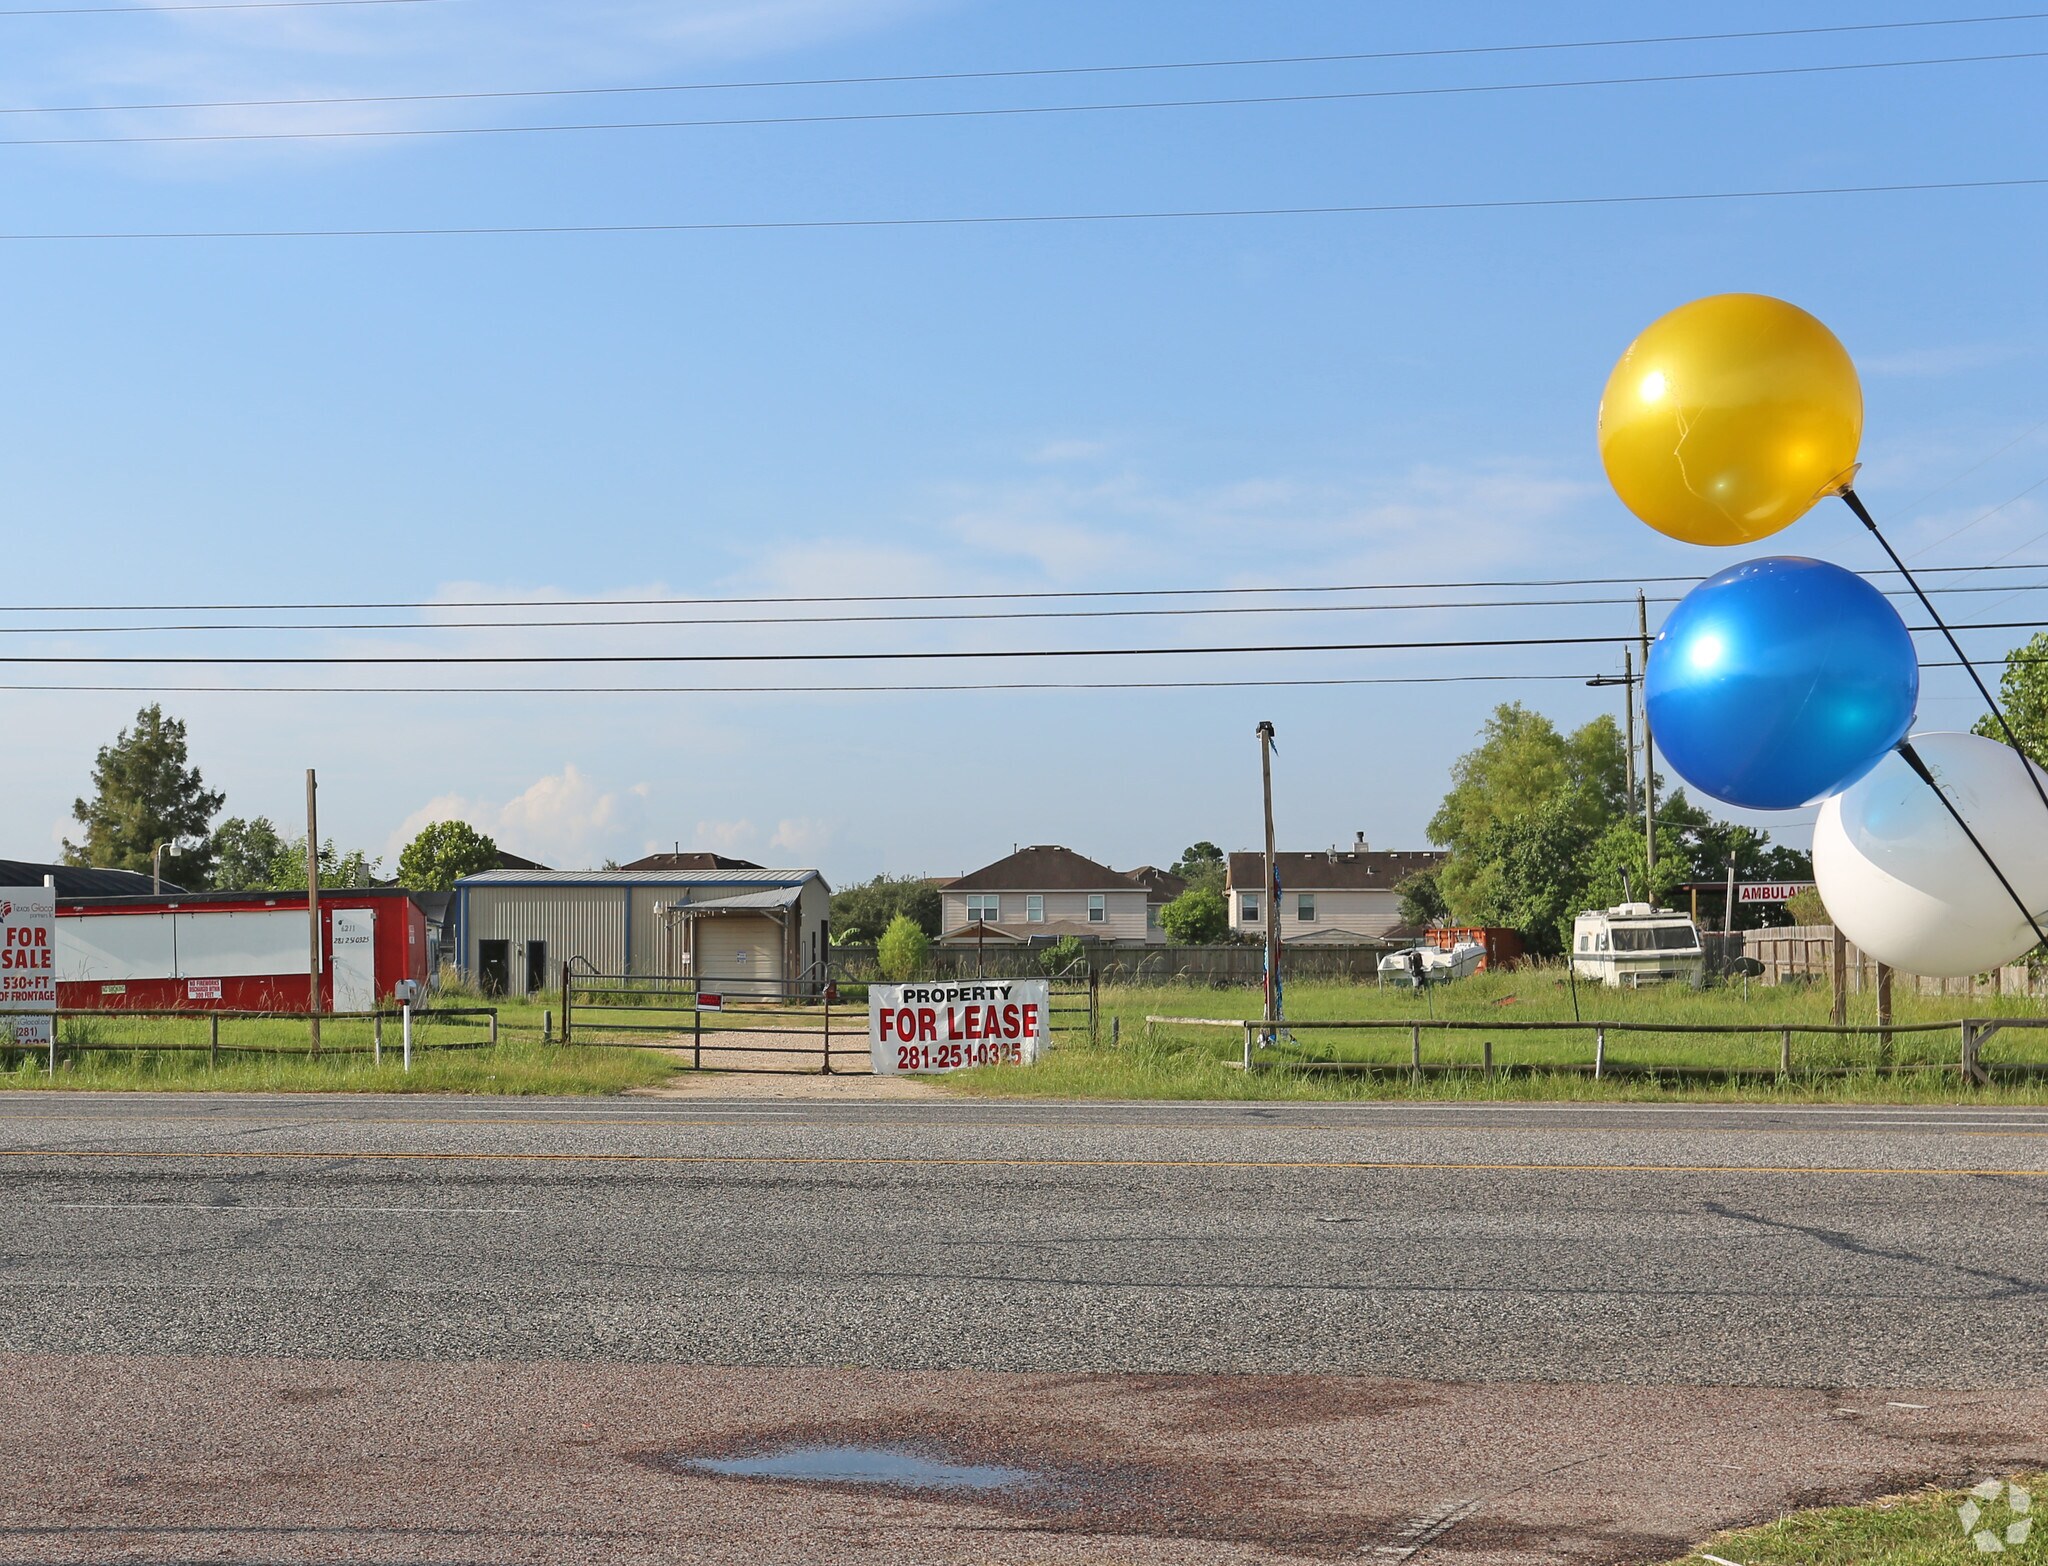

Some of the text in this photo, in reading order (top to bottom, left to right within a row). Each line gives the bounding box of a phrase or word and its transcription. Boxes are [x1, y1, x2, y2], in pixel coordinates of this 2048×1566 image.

[1742, 886, 1814, 899] AMBULA
[13, 902, 54, 912] Texas Glocal
[7, 927, 47, 947] FOR
[1, 949, 52, 969] SALE
[11, 990, 54, 1001] FRONTAGE
[903, 986, 1012, 1003] PROPERTY
[879, 1004, 1039, 1042] FOR LEASE
[16, 1027, 38, 1037] (281)
[897, 1043, 1022, 1069] 281-251-0325
